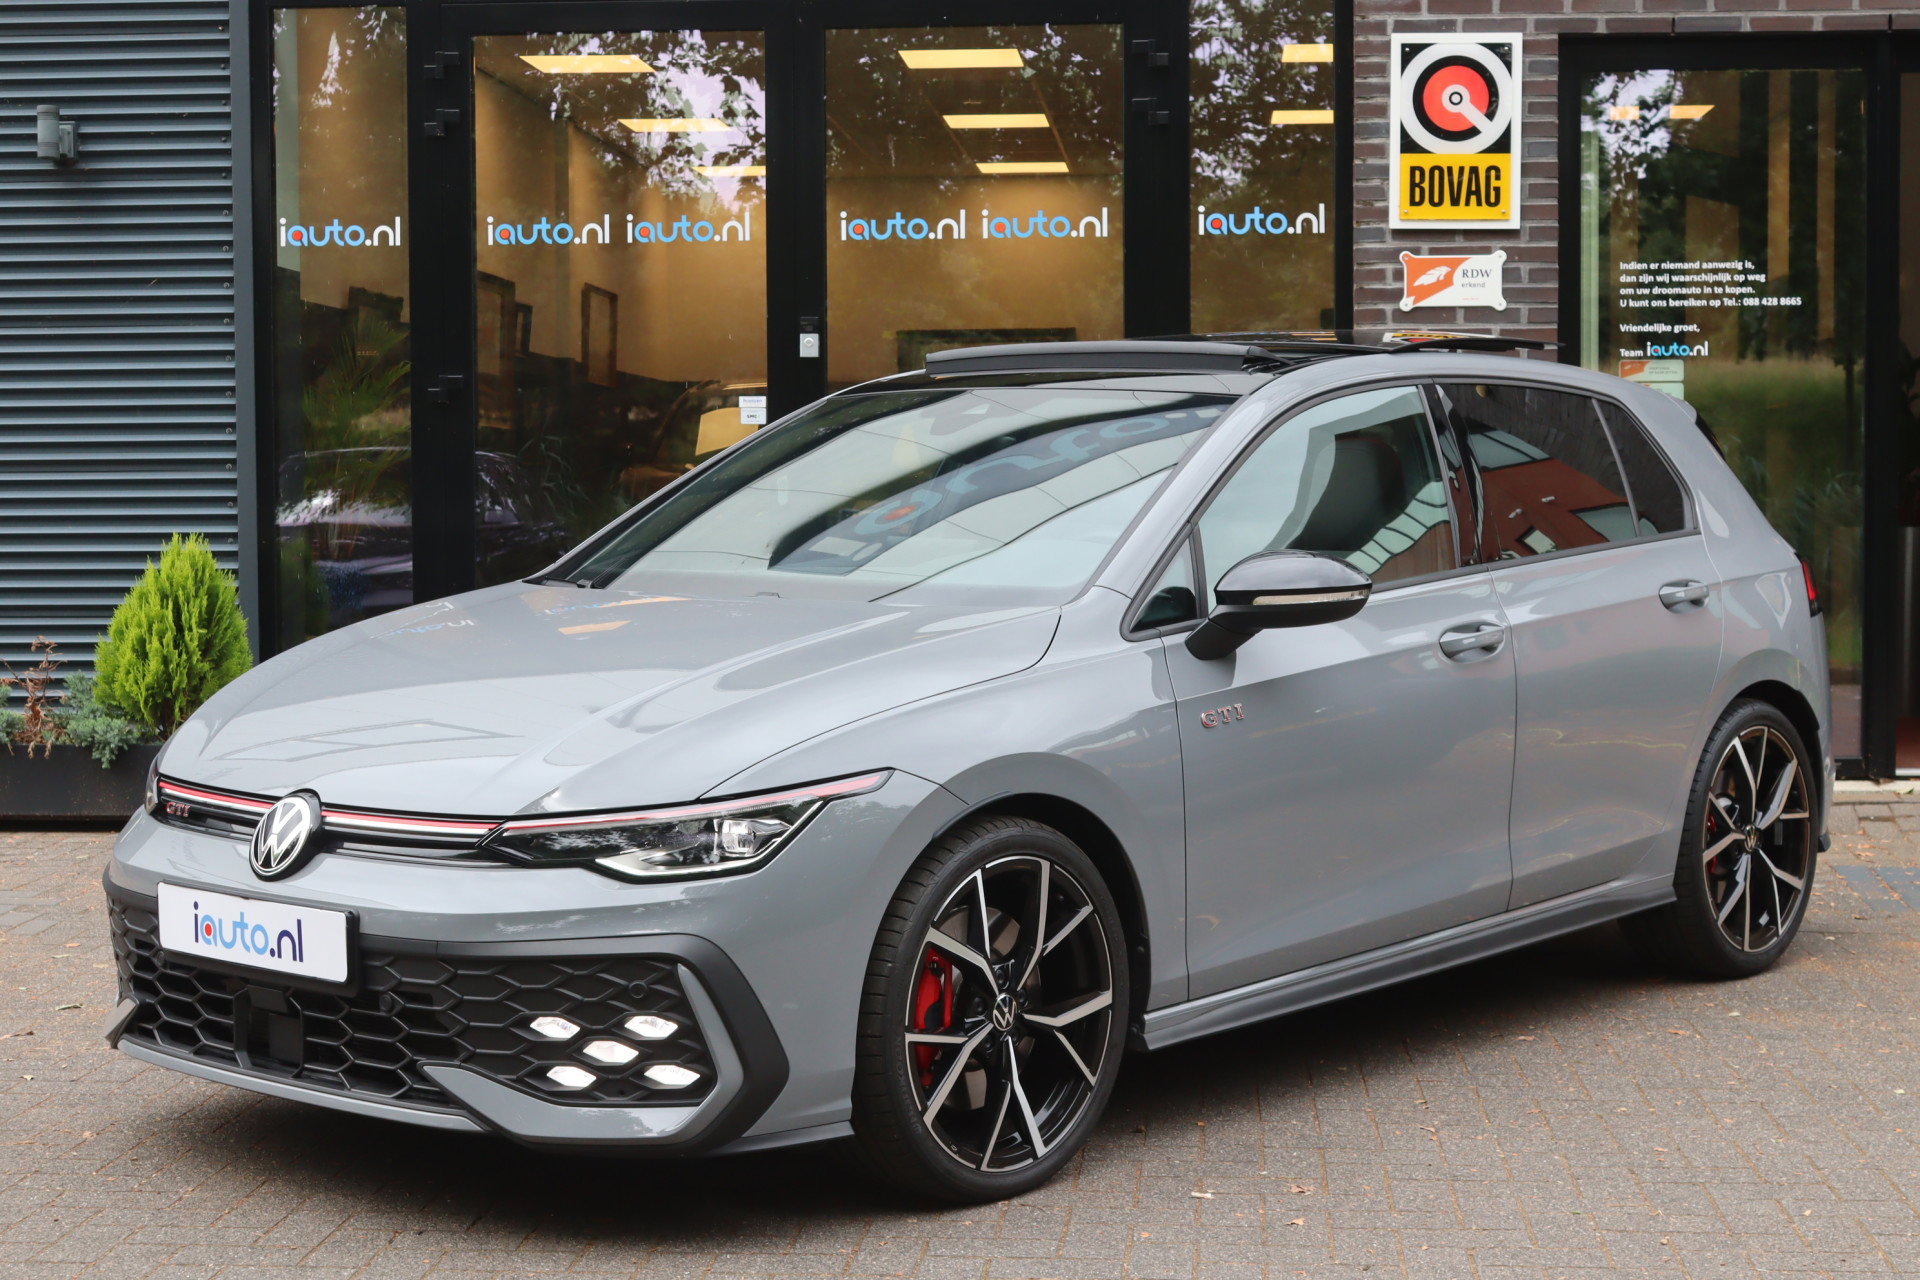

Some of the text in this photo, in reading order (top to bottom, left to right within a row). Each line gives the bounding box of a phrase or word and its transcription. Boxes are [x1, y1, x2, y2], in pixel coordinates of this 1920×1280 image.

[1409, 165, 1501, 208] BOVAG
[279, 216, 401, 248] iauto.nl
[486, 214, 610, 246] iauto.nl
[626, 212, 751, 244] iauto.nl
[839, 209, 966, 241] iauto.nl
[981, 206, 1108, 239] iauto.nl
[1197, 203, 1325, 236] iauto.nl
[1462, 269, 1492, 279] RDW
[1620, 262, 1648, 270] Indien
[1661, 261, 1700, 270] niemand
[1702, 260, 1743, 270] aanwezig
[1744, 260, 1755, 270] is,
[1620, 272, 1766, 284] dan zijn wij waarschijnlijk op weg
[1652, 286, 1701, 294] droomauto
[1703, 285, 1712, 294] in
[1714, 286, 1723, 294] te
[1725, 285, 1756, 295] kopen.
[1620, 299, 1627, 307] U
[1629, 299, 1649, 307] kunt
[1669, 298, 1707, 307] bereiken
[1709, 299, 1721, 308] op
[1743, 297, 1760, 306] 088
[1761, 297, 1778, 306] 428
[1780, 297, 1802, 306] 8665
[1620, 323, 1700, 333] Vriendelijke groet,
[1619, 341, 1709, 357] Team iauto.nl
[1201, 703, 1244, 728] GTI
[166, 801, 190, 817] GTI
[193, 900, 304, 963] iauto.nl
